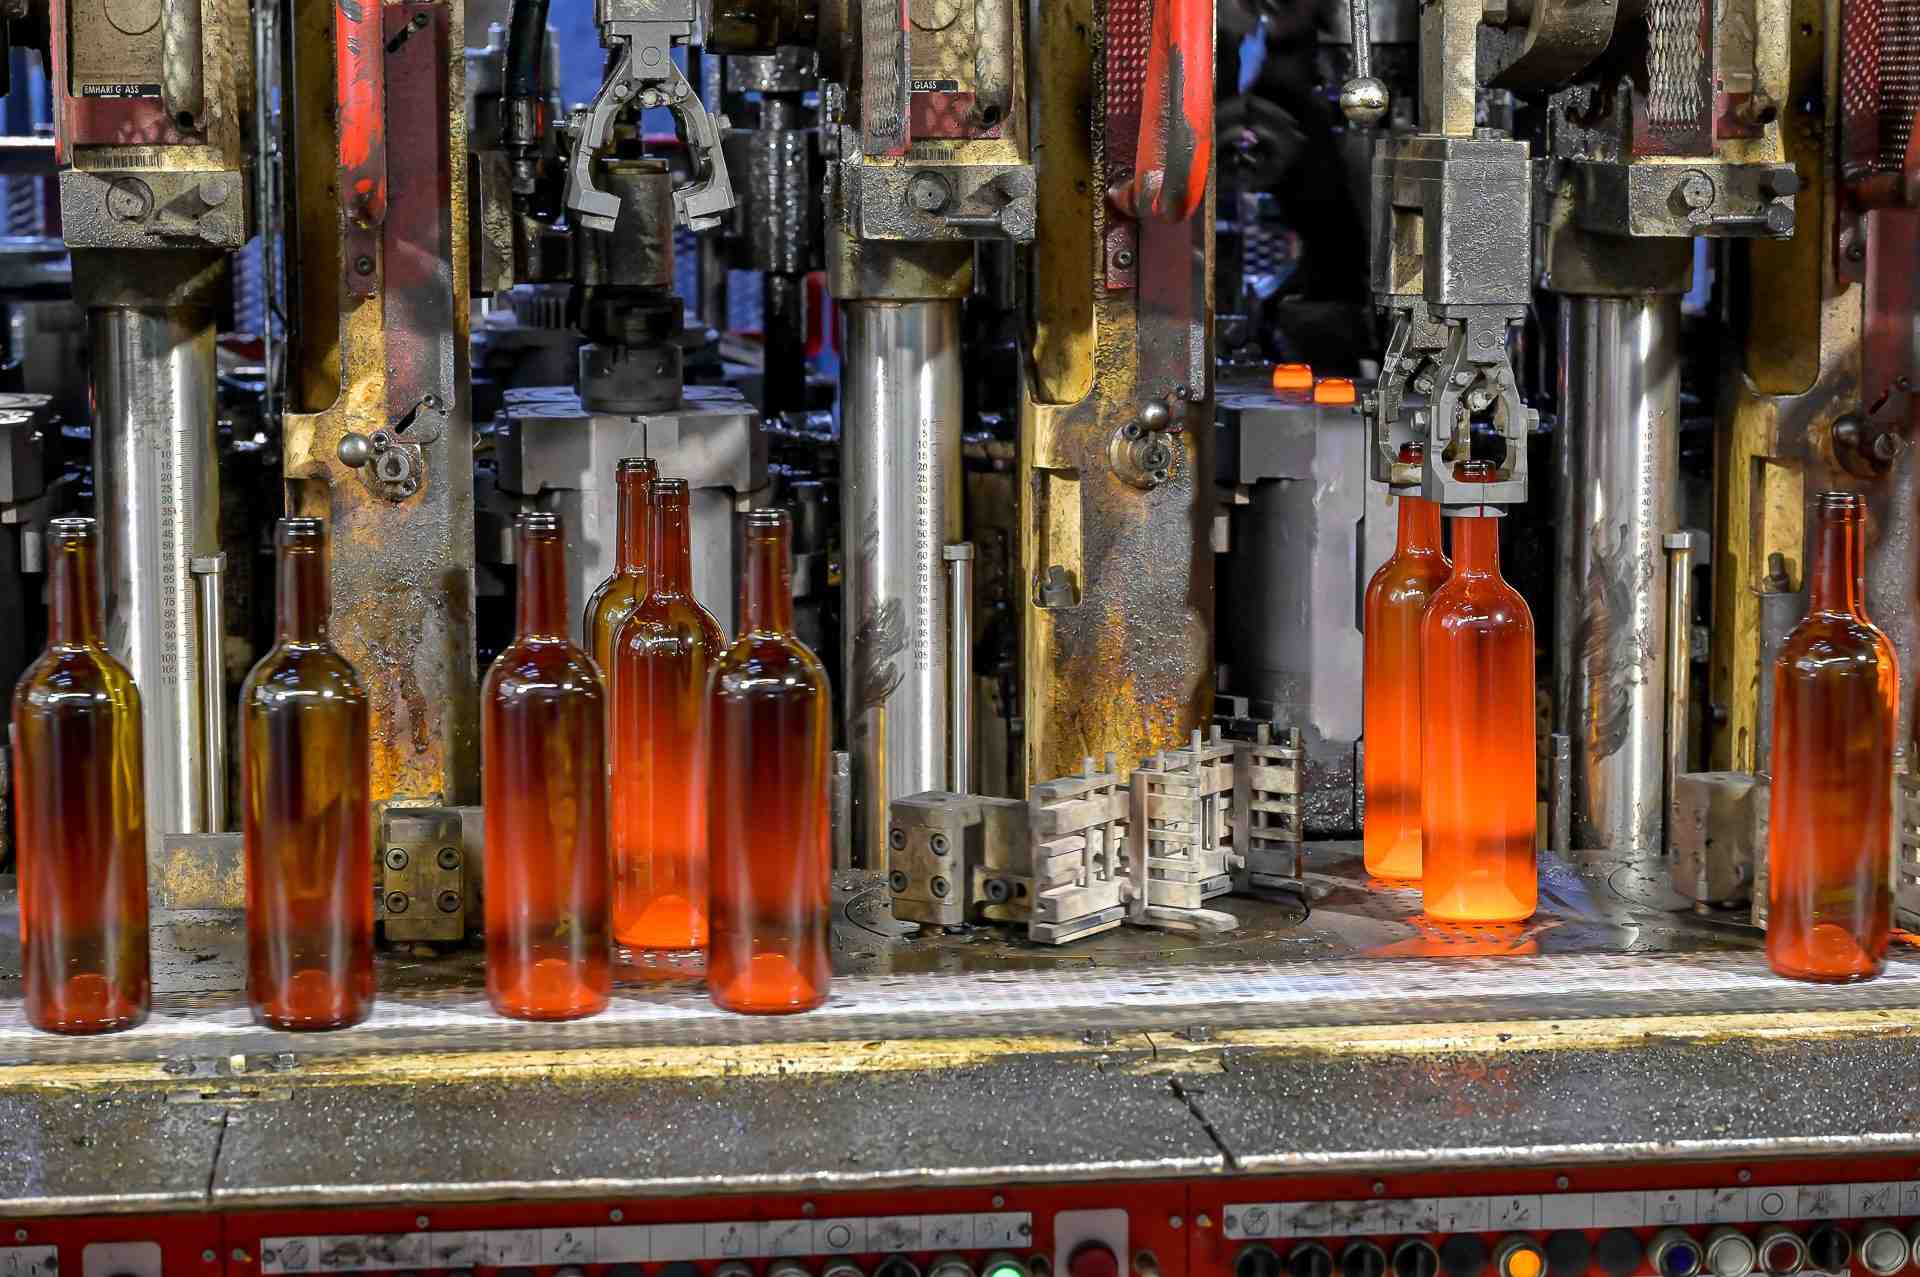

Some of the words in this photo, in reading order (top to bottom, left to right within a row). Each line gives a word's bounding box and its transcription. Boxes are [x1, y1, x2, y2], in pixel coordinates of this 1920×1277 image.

[914, 80, 937, 89] GLASS
[115, 85, 140, 94] GASS
[161, 450, 172, 458] 10
[917, 463, 928, 472] 20
[160, 472, 172, 481] 20
[161, 496, 172, 505] 30
